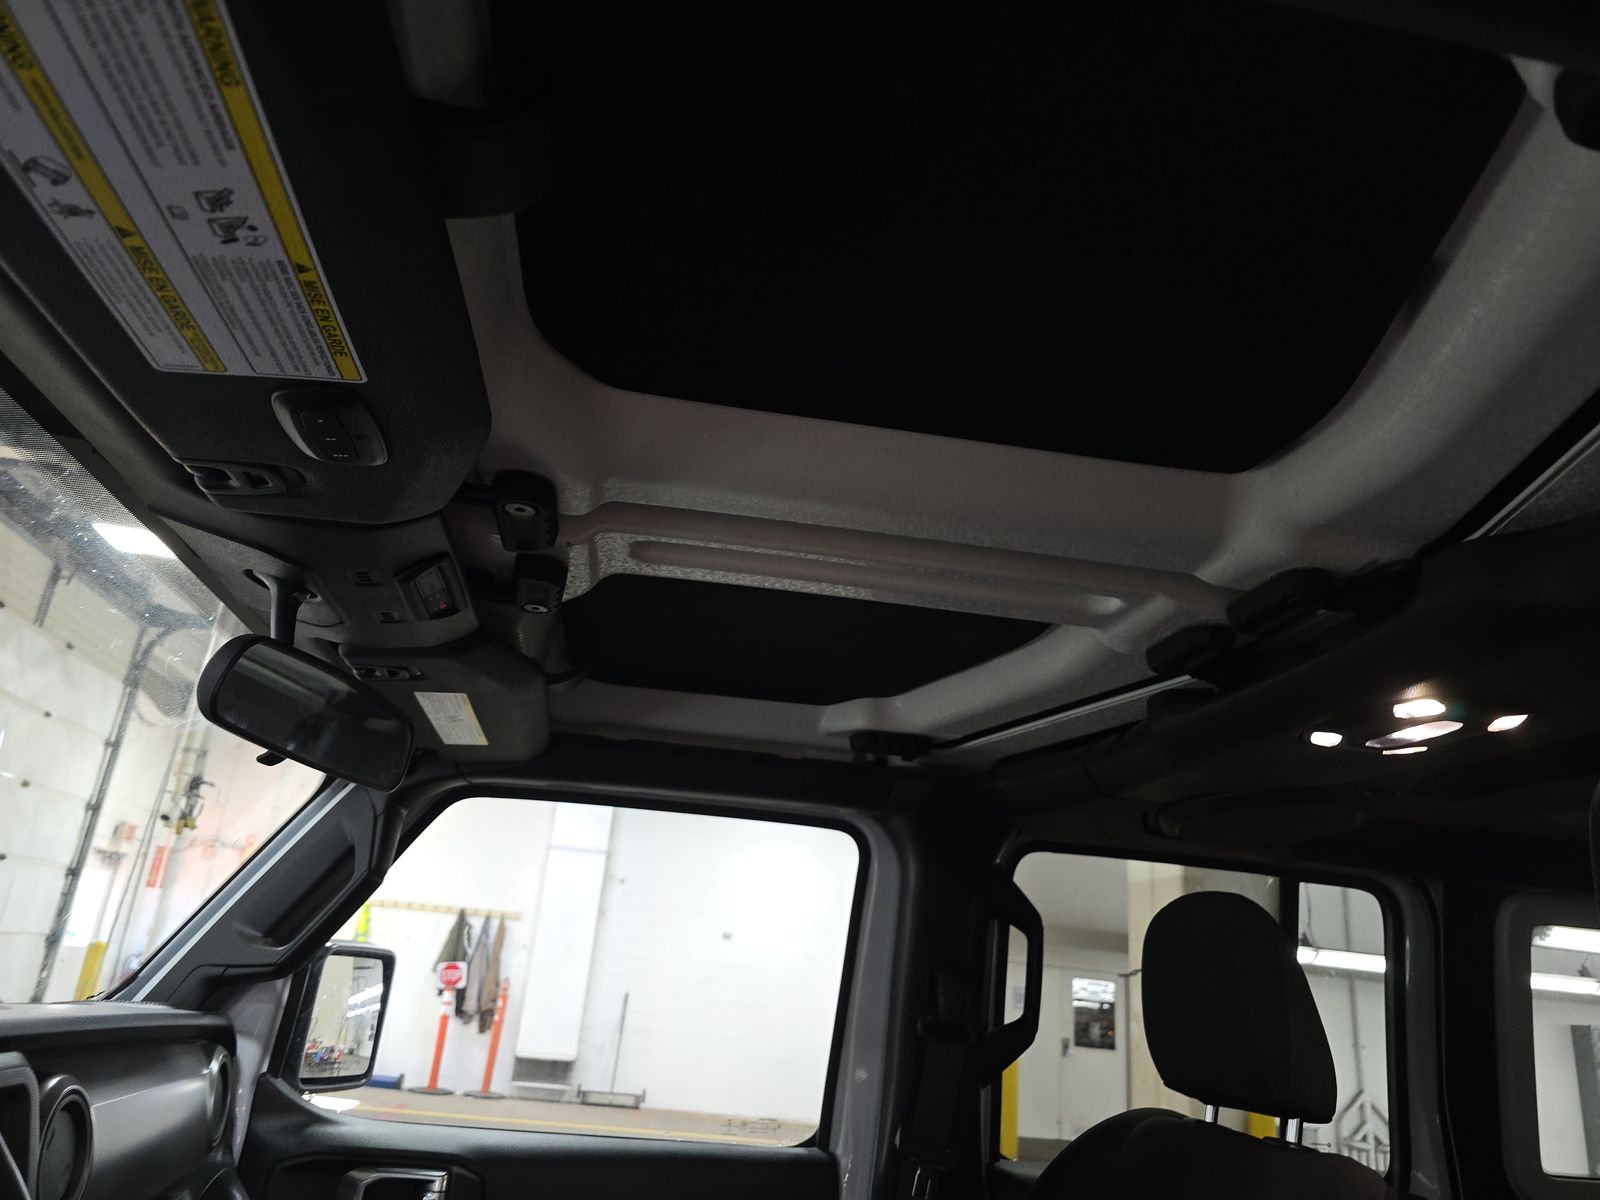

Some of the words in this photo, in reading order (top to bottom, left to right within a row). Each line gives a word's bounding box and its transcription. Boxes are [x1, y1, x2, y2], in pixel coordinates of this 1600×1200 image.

[128, 245, 160, 274] MISE
[147, 275, 171, 292] EN
[160, 295, 194, 327] GARDE
[302, 280, 325, 305] MISE
[314, 308, 332, 322] EN
[322, 324, 348, 357] GARDE
[441, 969, 462, 980] STOP
